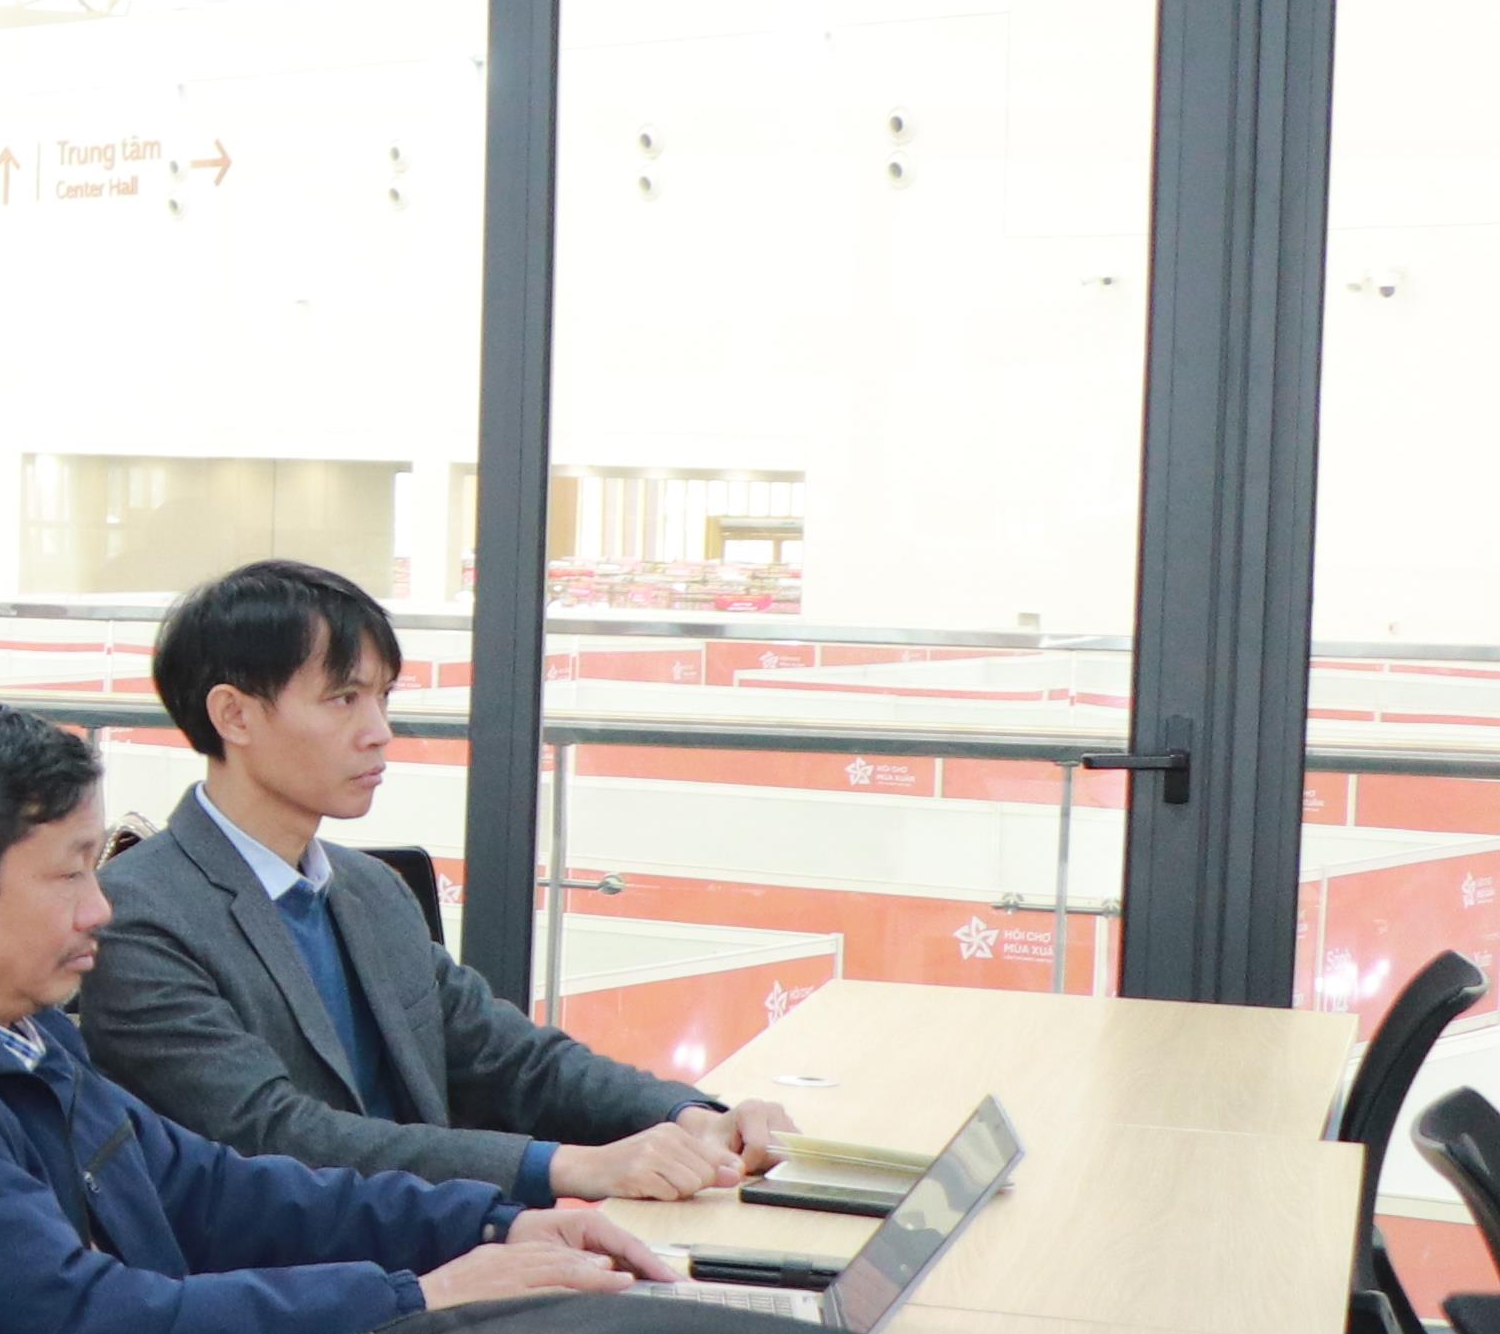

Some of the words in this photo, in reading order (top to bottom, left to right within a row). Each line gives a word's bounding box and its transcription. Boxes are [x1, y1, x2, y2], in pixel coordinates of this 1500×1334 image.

[57, 140, 116, 171] Trung
[56, 180, 104, 200] Center
[108, 176, 139, 196] Hall
